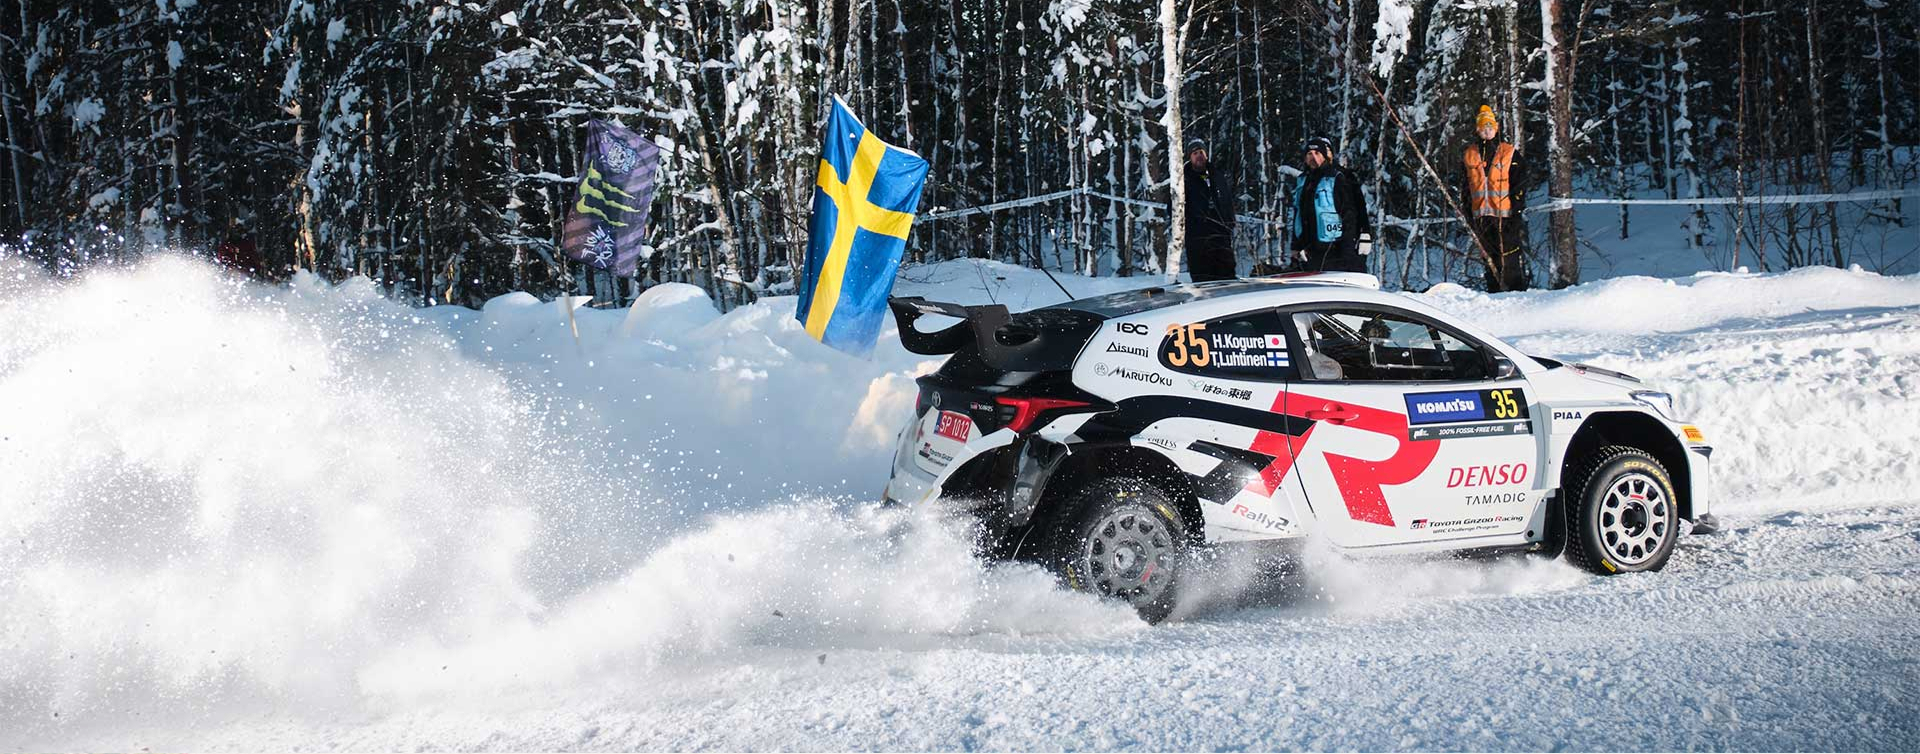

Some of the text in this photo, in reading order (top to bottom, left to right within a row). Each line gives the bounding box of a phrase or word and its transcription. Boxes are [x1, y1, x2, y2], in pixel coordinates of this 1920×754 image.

[1166, 322, 1211, 368] 35
[1212, 333, 1265, 352] H.Kogure
[1416, 398, 1475, 414] KOMATSU
[1491, 389, 1519, 419] 35
[1553, 411, 1582, 420] PIAA
[940, 415, 970, 440] SP 1012
[1446, 463, 1528, 488] DENSO
[1465, 492, 1526, 505] TAMADIC
[1232, 505, 1290, 531] Rally2
